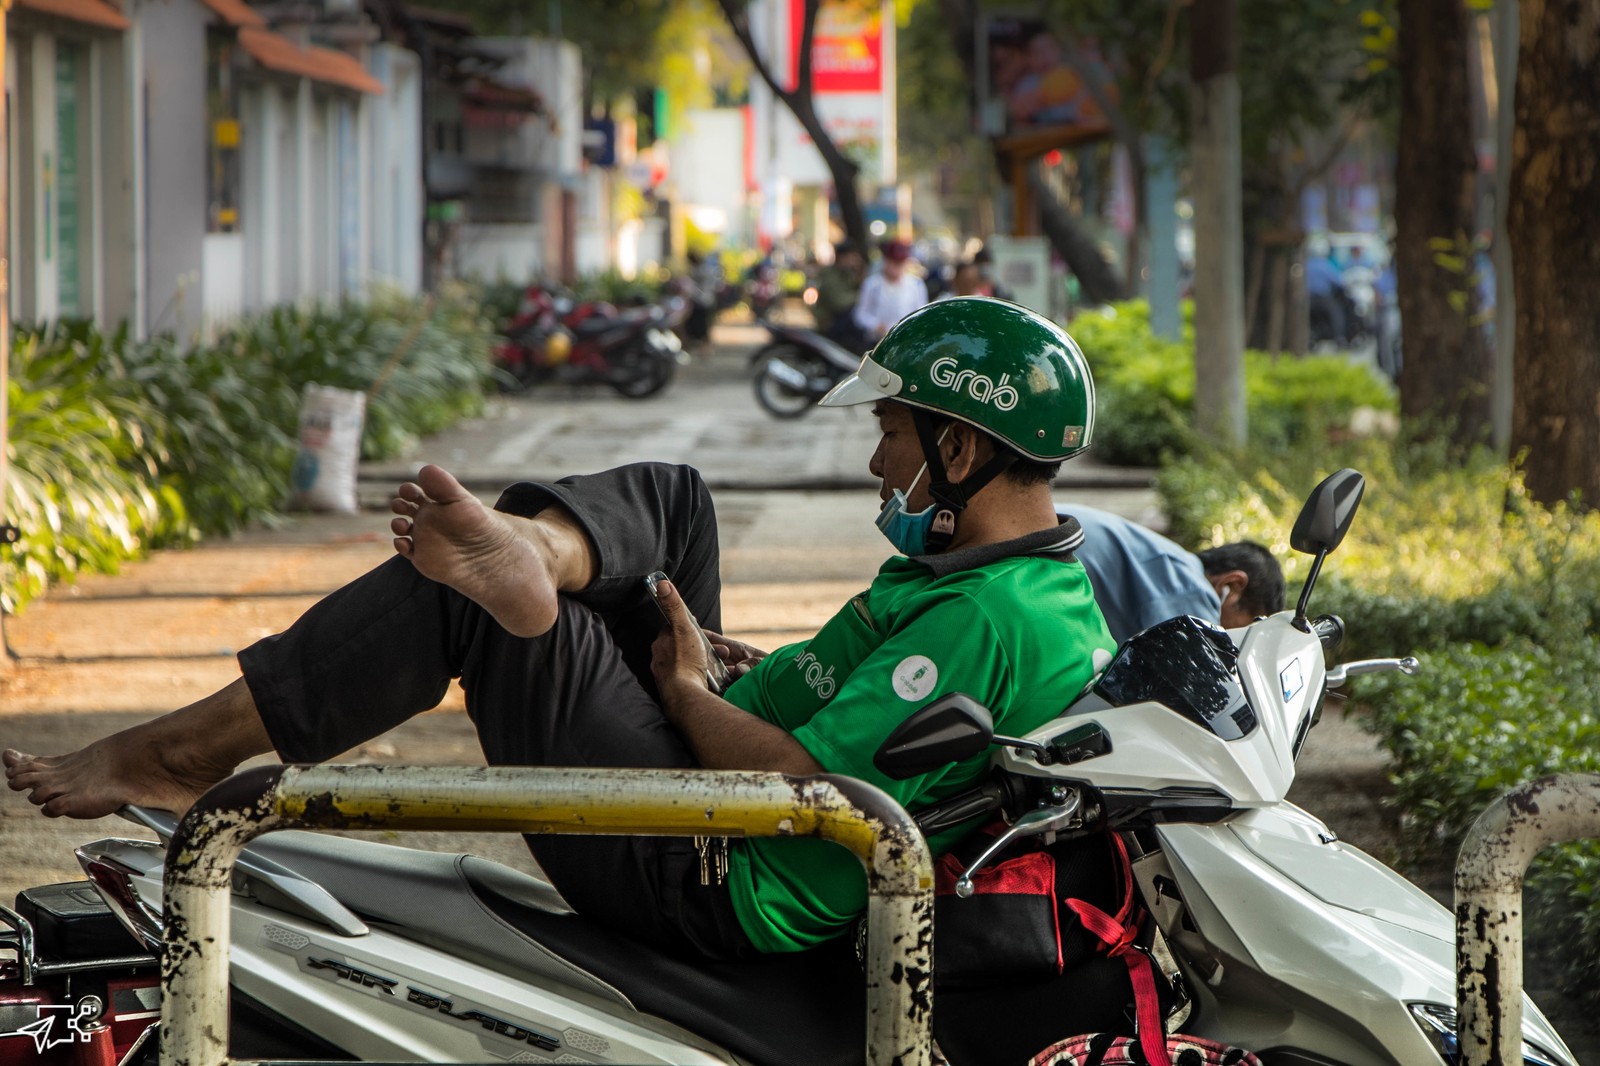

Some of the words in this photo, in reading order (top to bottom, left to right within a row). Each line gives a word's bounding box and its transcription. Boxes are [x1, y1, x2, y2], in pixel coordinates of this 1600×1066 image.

[930, 357, 1019, 411] Grab
[307, 956, 398, 996] AIR
[406, 985, 561, 1051] BLADE
